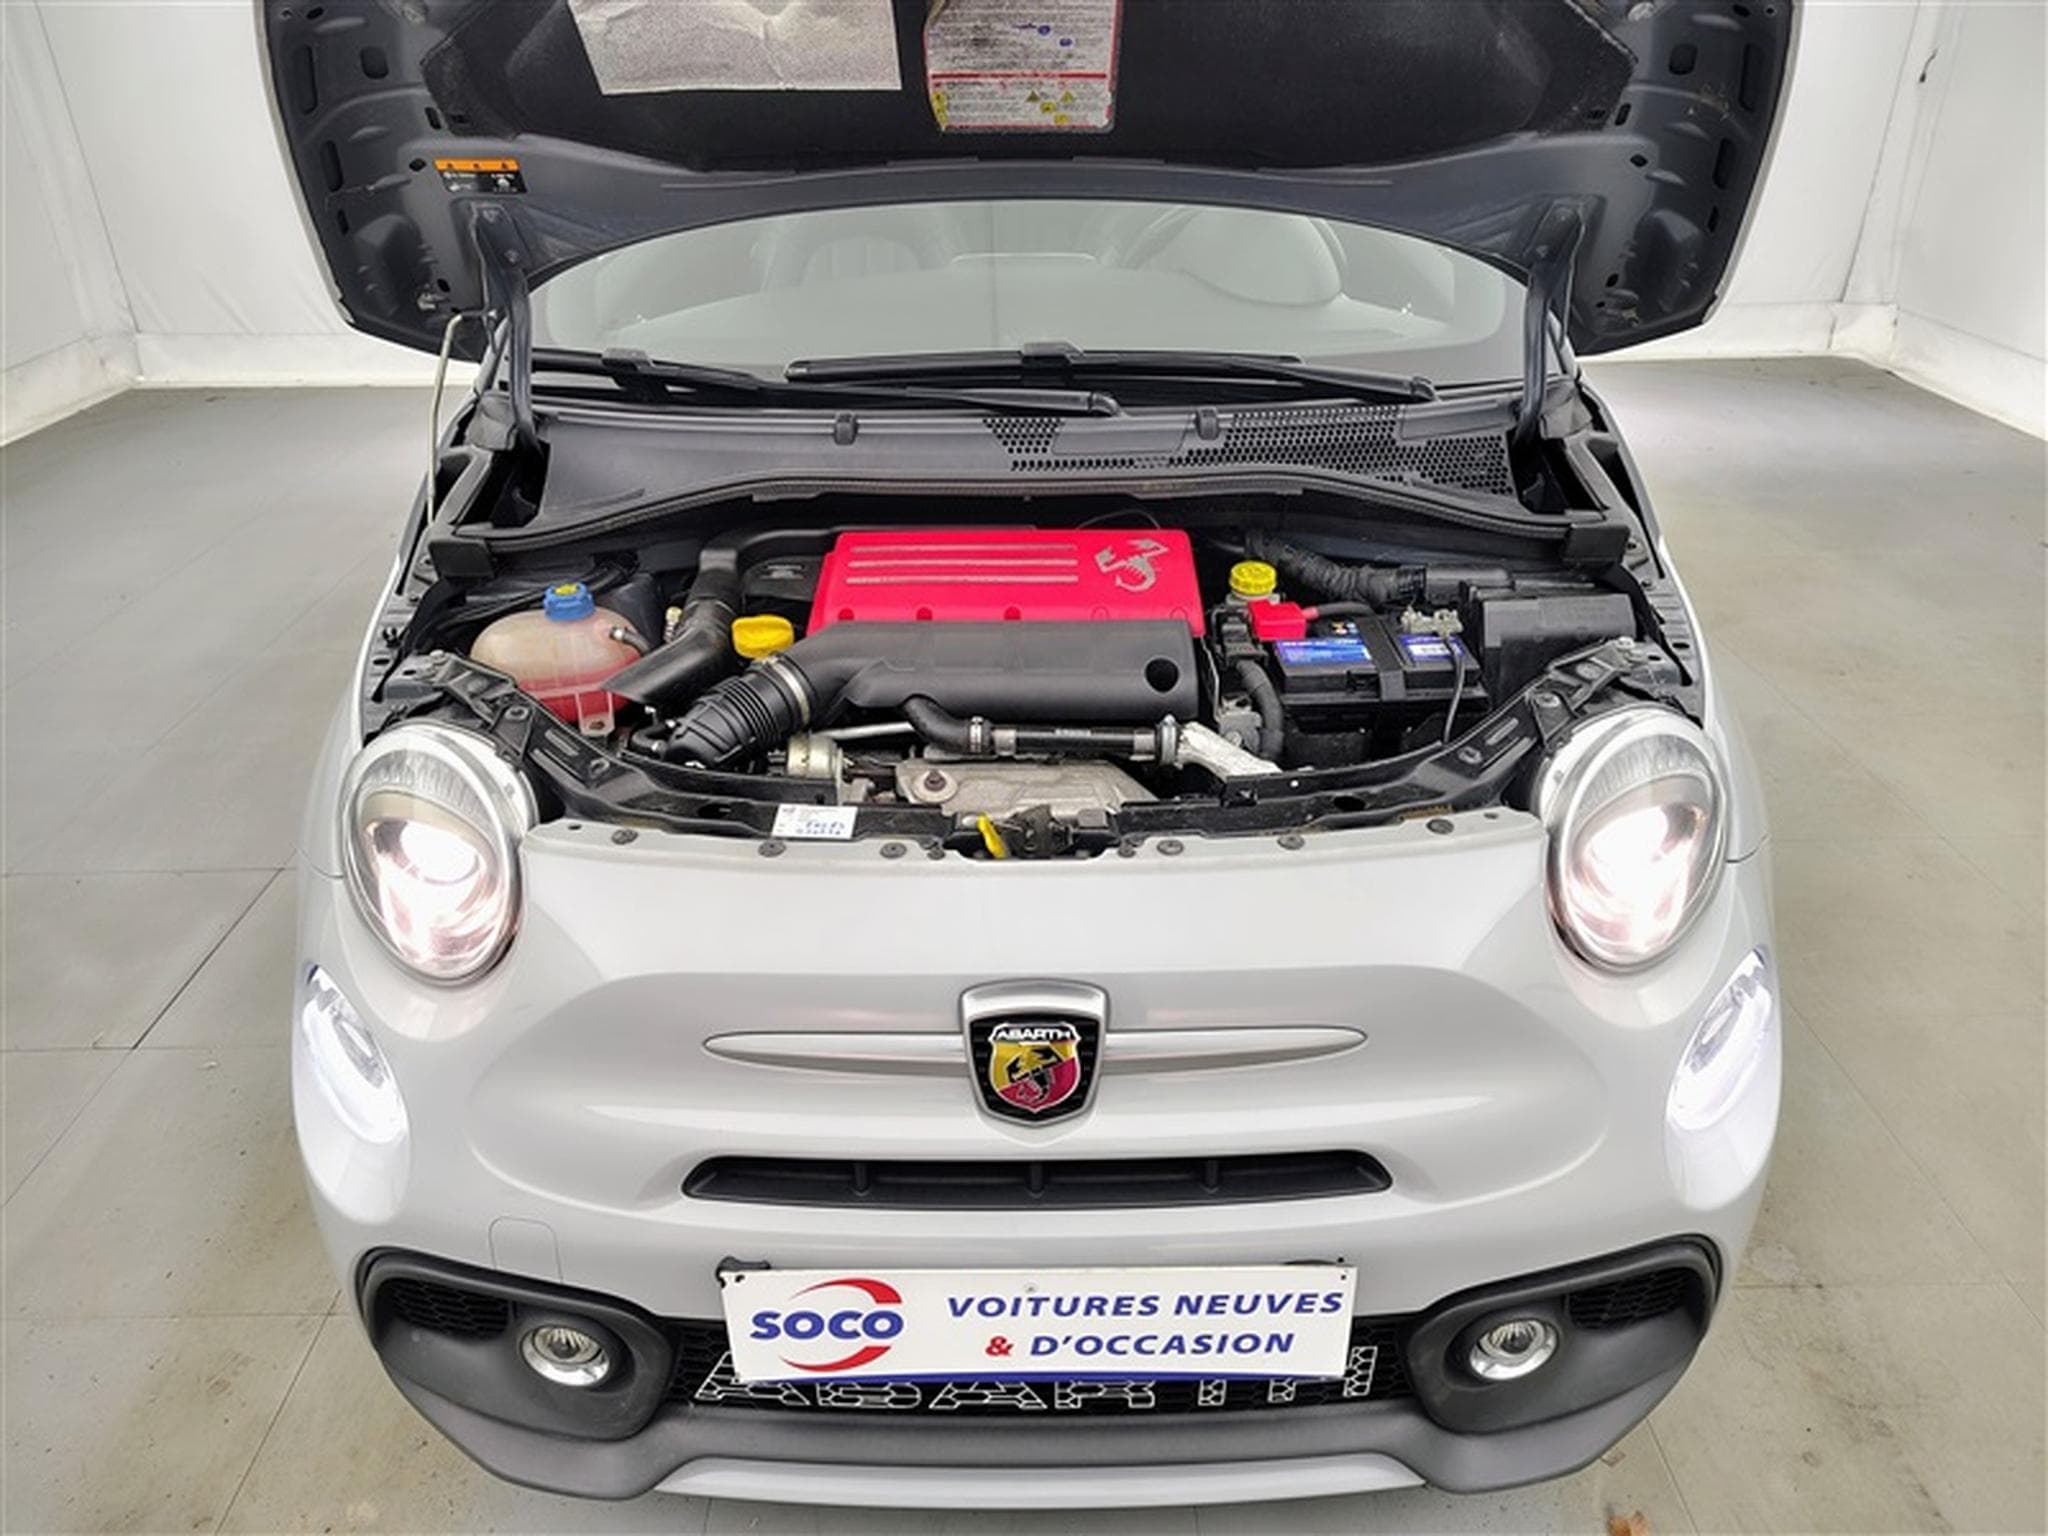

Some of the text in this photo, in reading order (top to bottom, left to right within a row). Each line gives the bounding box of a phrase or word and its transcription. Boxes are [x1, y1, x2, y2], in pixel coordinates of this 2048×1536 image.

[996, 1028, 1071, 1041] ABARTH
[948, 1292, 1343, 1318] VOITURES NEUVES
[750, 1309, 904, 1340] SOCO
[985, 1333, 1295, 1357] & D'OCCASION
